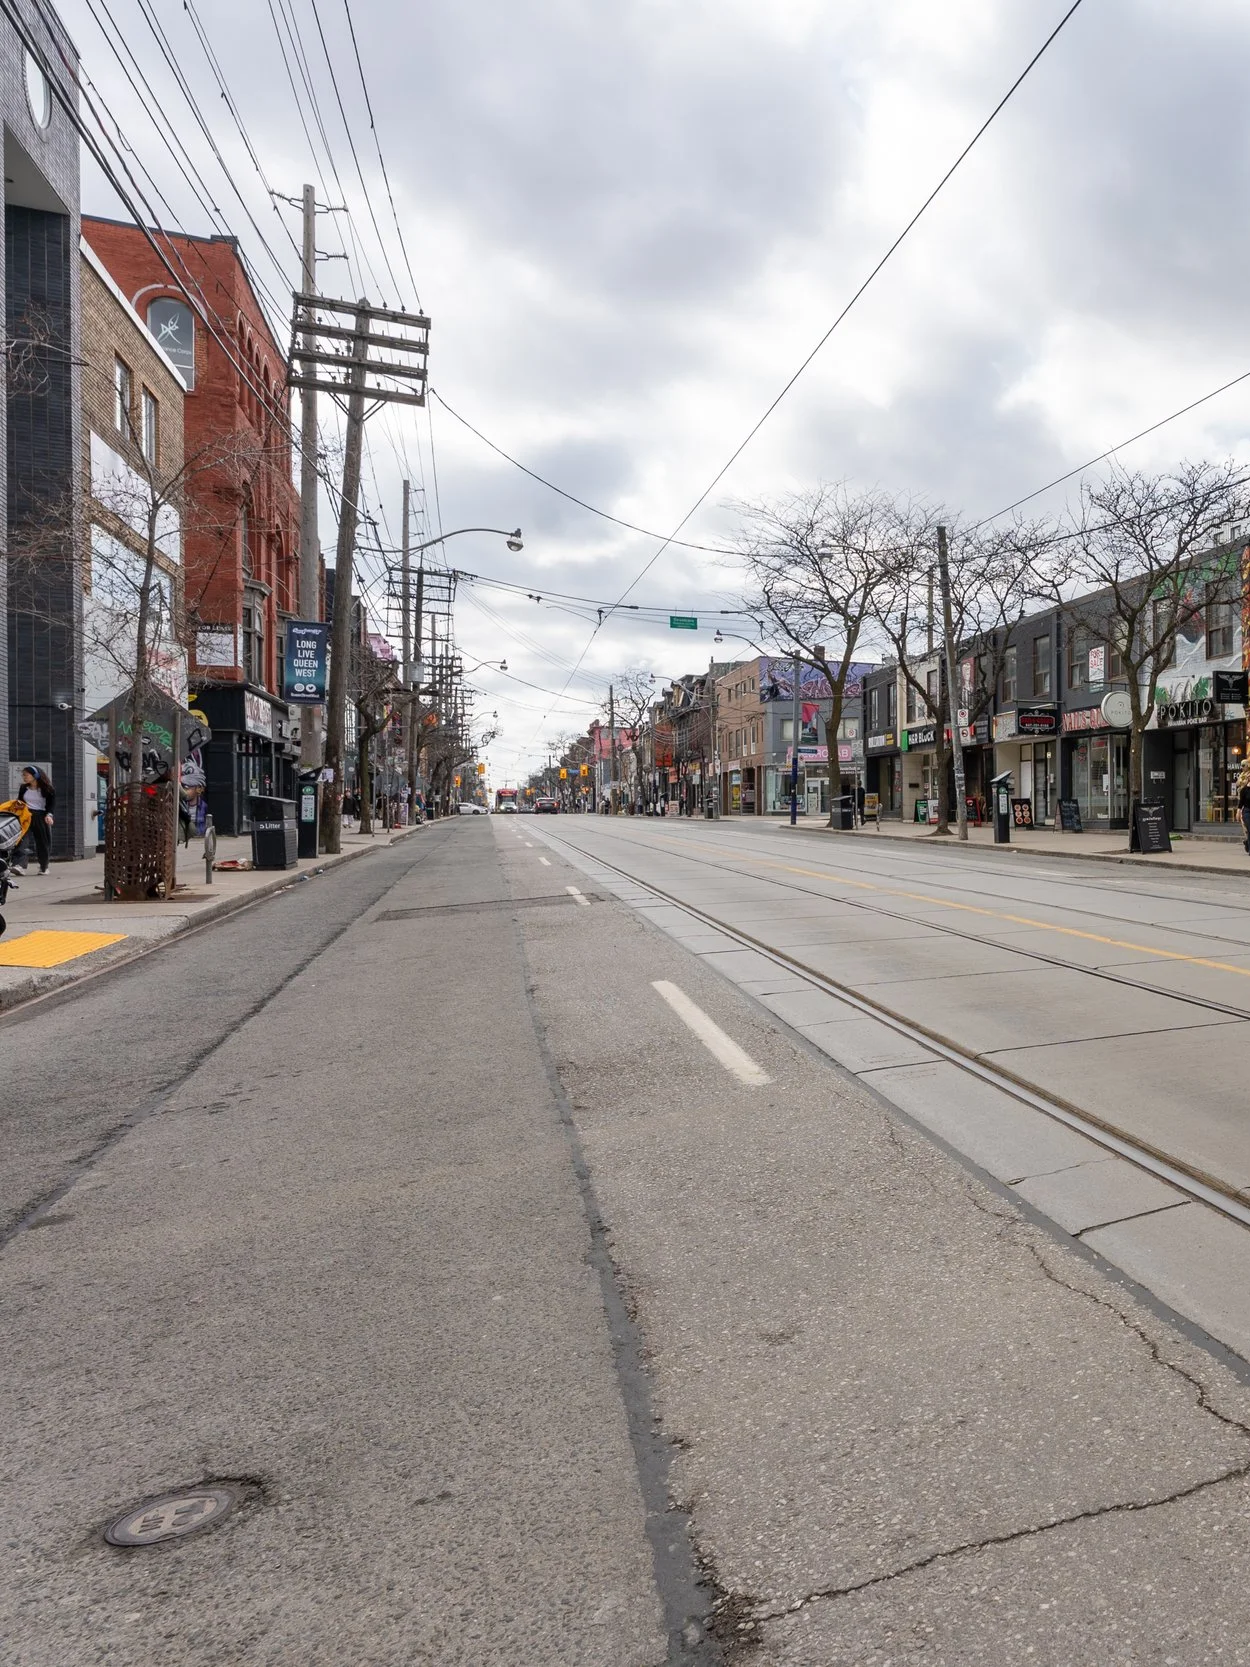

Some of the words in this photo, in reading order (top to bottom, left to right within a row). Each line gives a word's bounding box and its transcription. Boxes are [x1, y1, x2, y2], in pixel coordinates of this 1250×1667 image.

[296, 640, 317, 649] LONG
[298, 650, 315, 659] LIVE
[293, 659, 319, 669] QUEEN
[295, 668, 317, 678] WEST
[1160, 700, 1212, 720] POKITO
[1187, 718, 1198, 726] POKE
[918, 730, 935, 744] BLOCK
